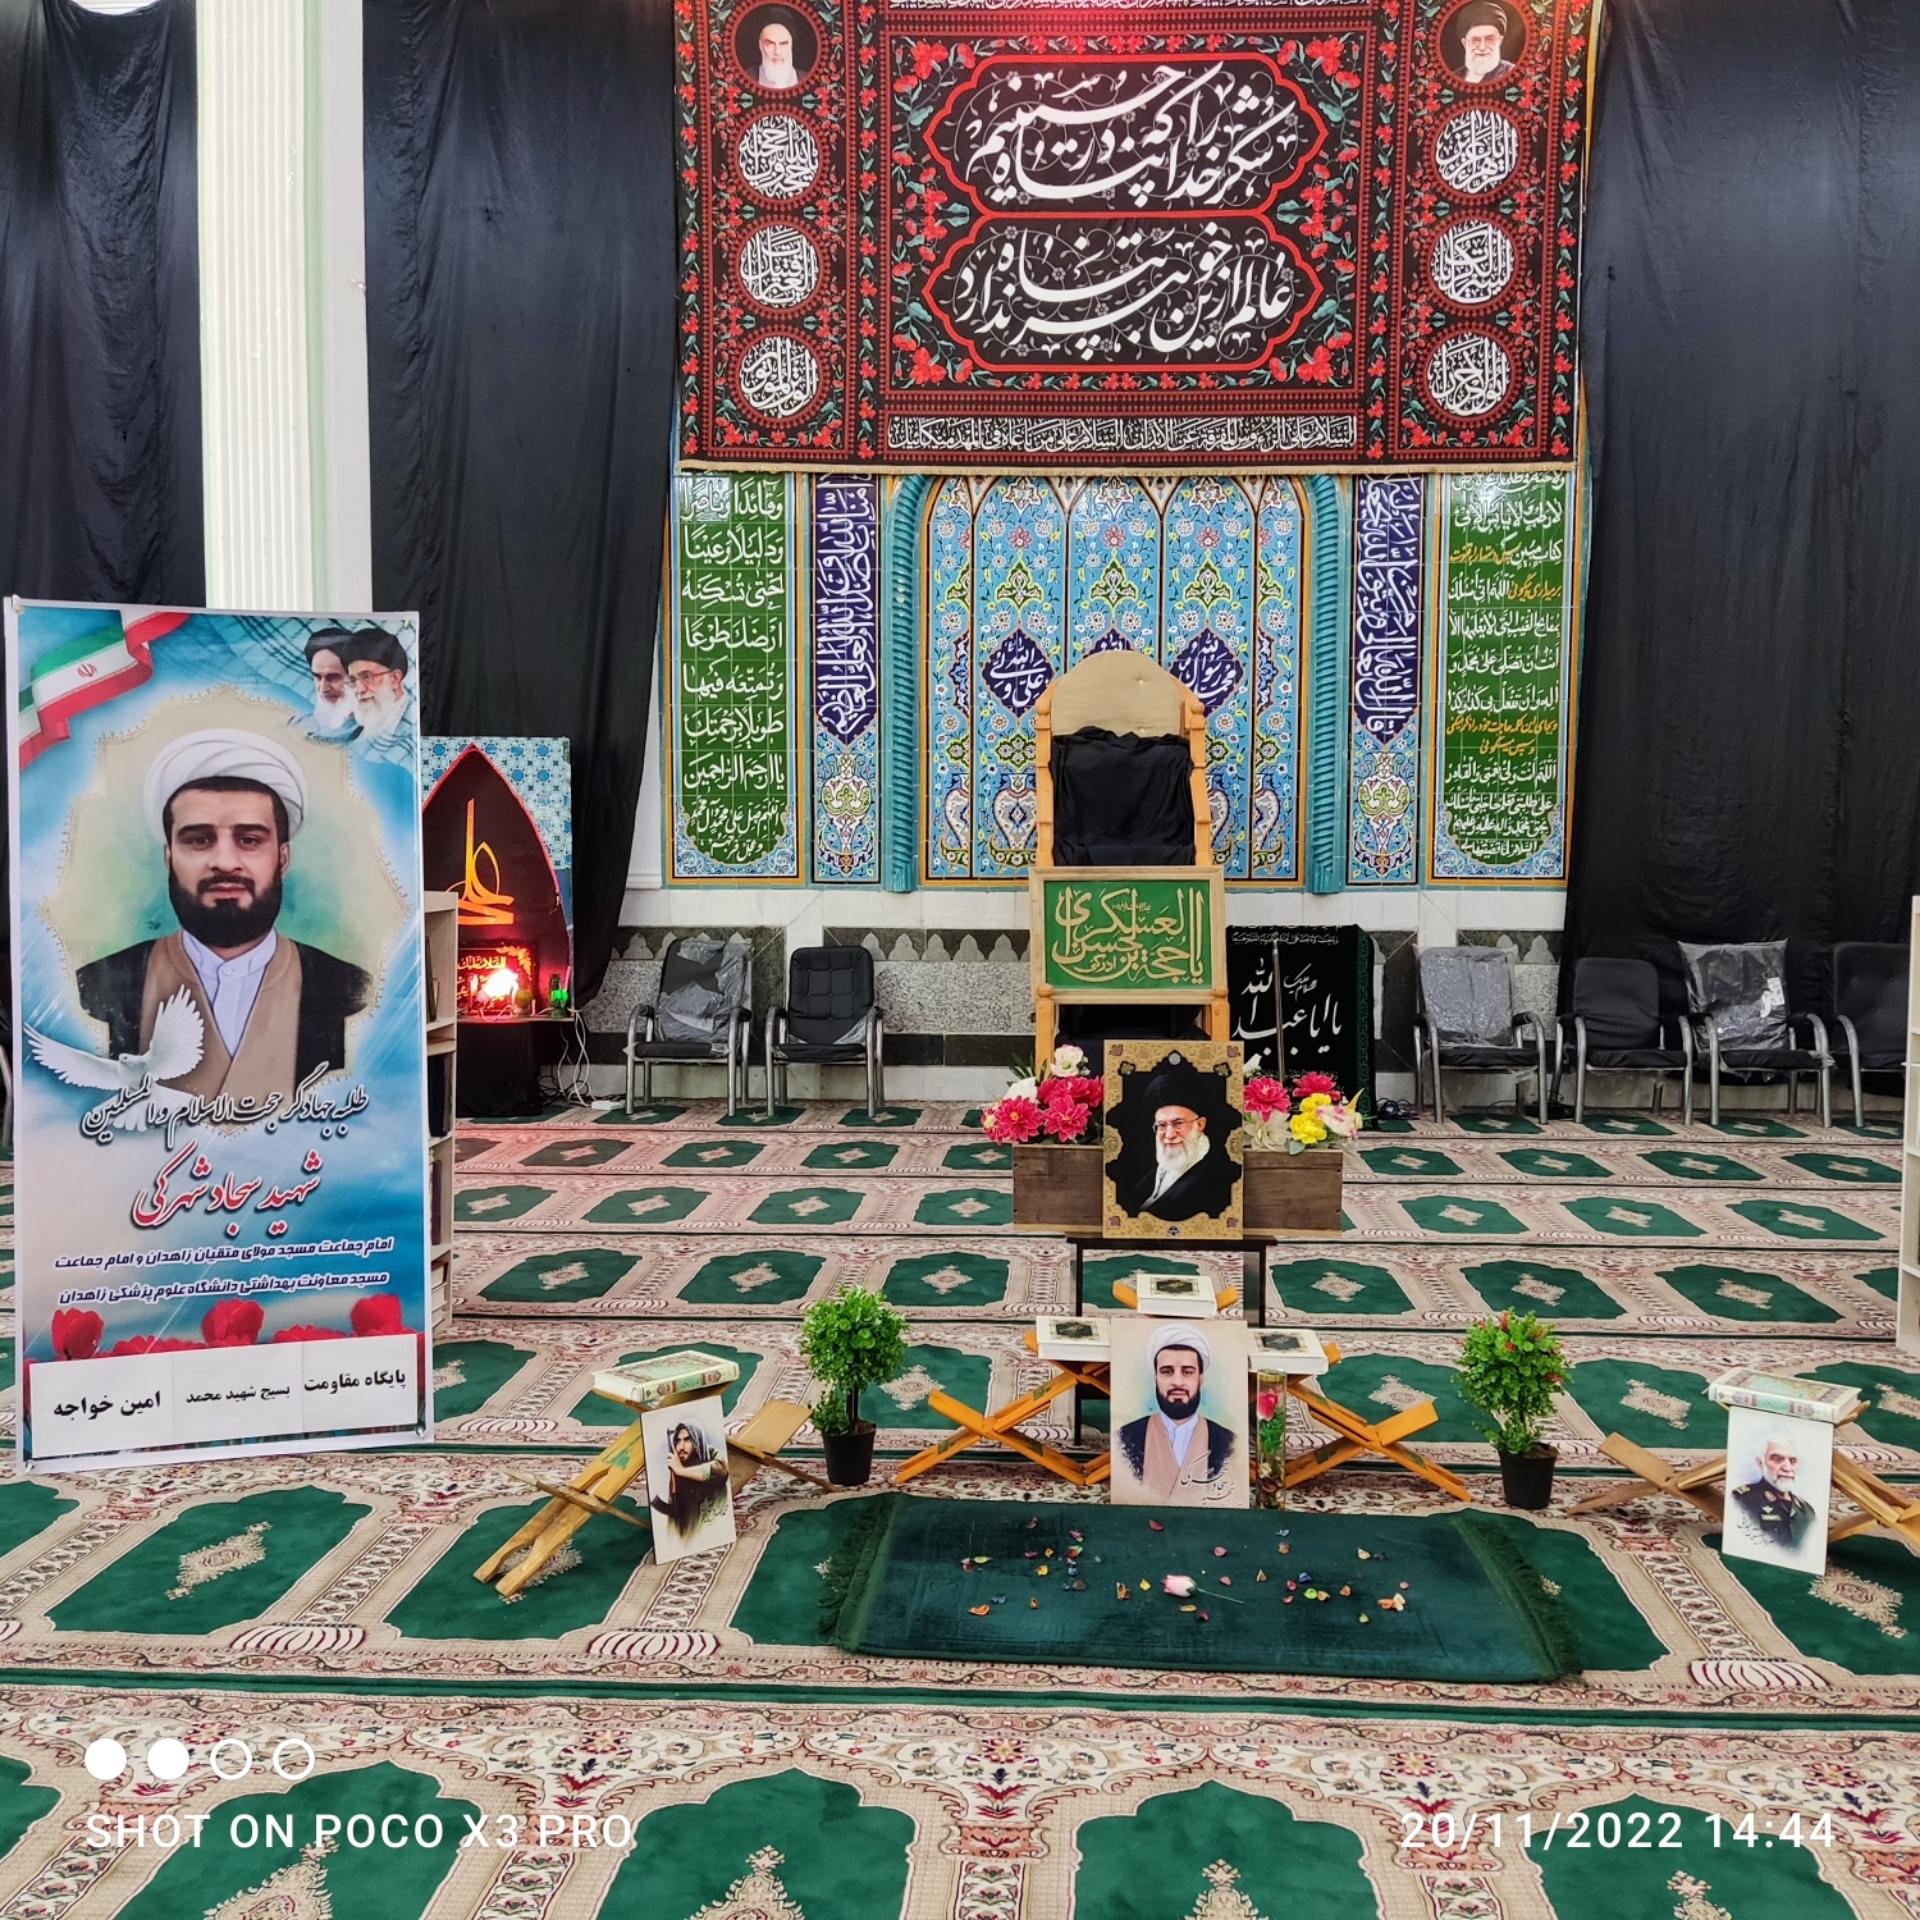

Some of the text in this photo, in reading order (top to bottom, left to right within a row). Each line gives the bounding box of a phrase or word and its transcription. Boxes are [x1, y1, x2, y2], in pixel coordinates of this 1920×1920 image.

[279, 1061, 335, 1138] جهادگر
[332, 1084, 370, 1136] طلبه
[132, 1140, 323, 1236] شهید سجاد شهرکی
[54, 1238, 395, 1273] امام جماعت مسجد مولای متقیان زاهدان و امام جماعت
[59, 1273, 389, 1306] مسجد معاونت بهداشتی دانشگاه علوم پزشکی زاهدان
[185, 1385, 292, 1405] بسیج شهید محمد
[303, 1369, 407, 1393] پایگاه مقاومت
[53, 1390, 162, 1423] امین خواجه
